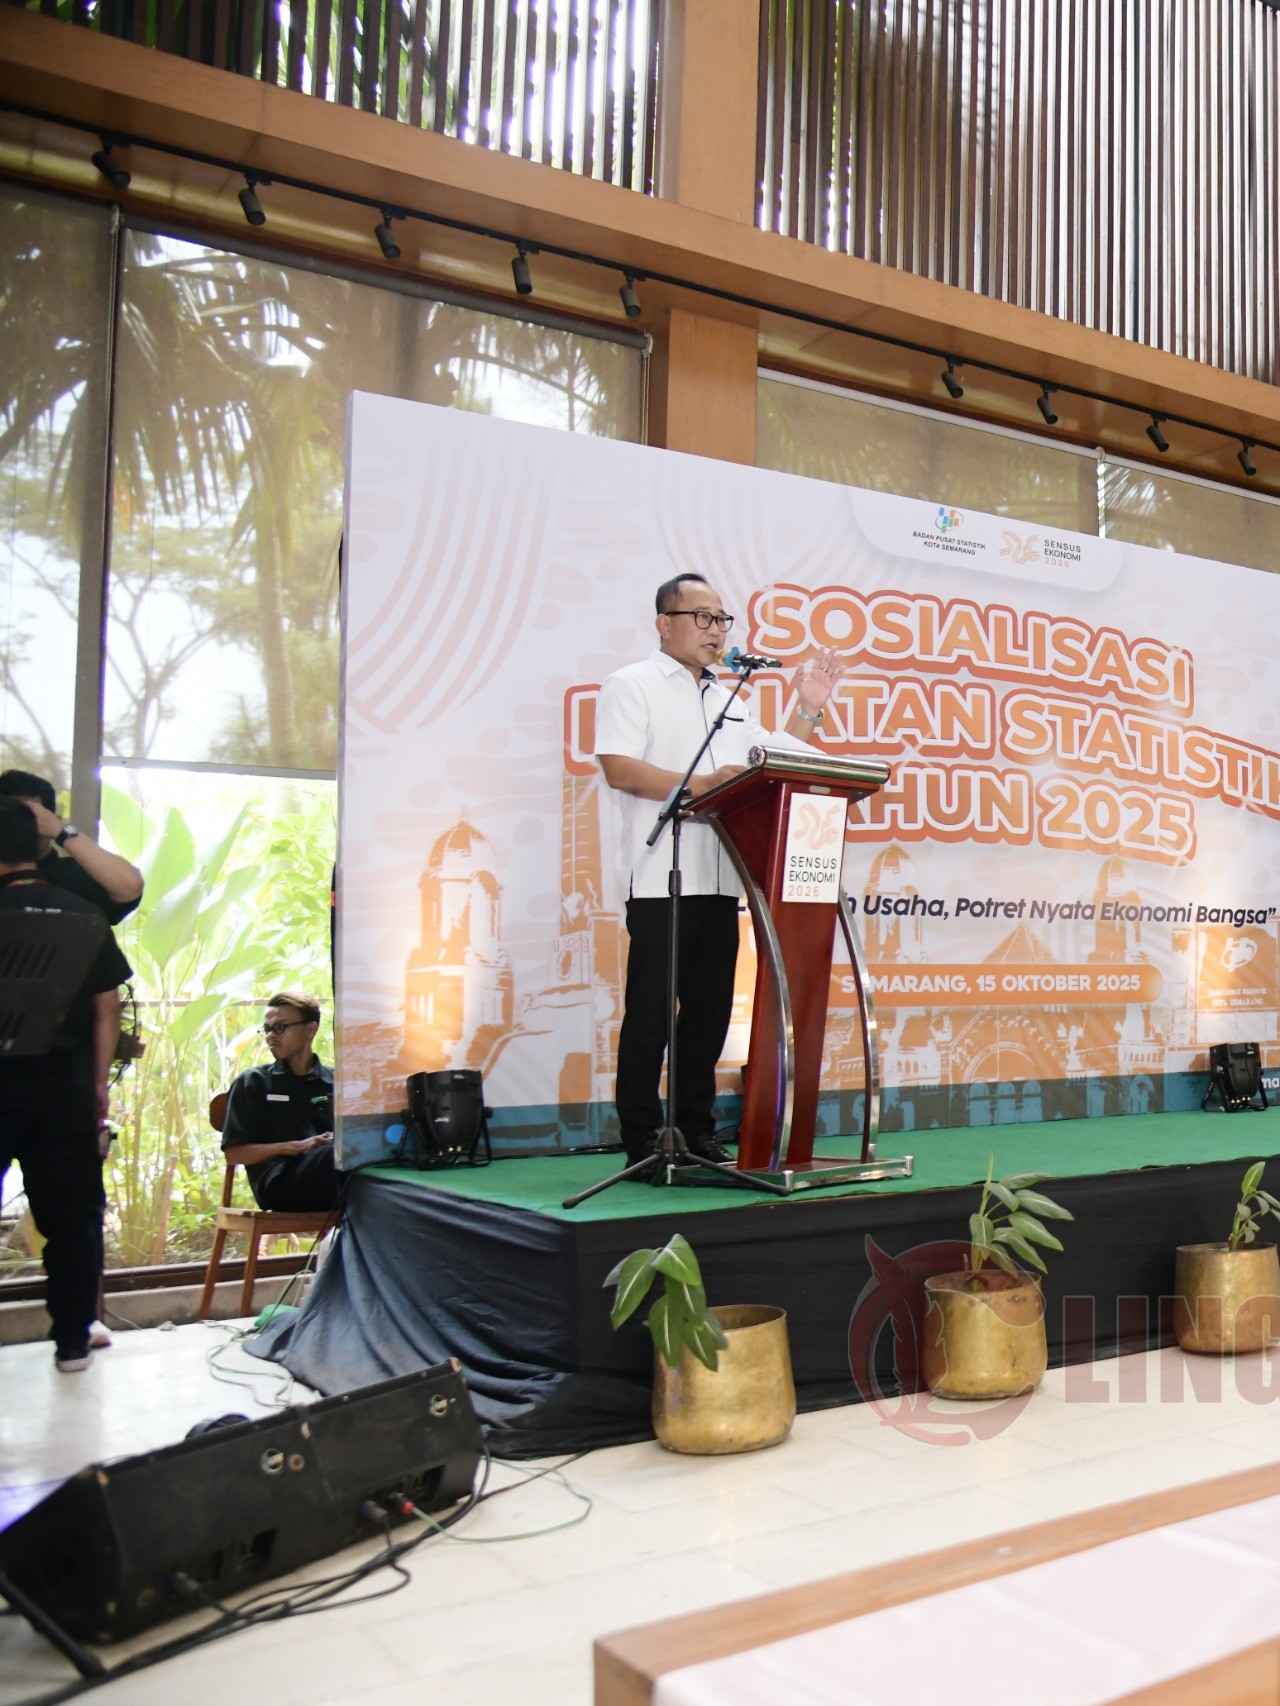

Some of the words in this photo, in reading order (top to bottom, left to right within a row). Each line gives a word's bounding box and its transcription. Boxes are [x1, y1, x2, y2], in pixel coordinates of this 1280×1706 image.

[912, 531, 934, 540] BADAN
[936, 535, 956, 544] PUSAT
[957, 539, 986, 550] STATISTIK
[1044, 539, 1081, 553] SENSUS
[923, 541, 941, 550] KOTA
[941, 544, 976, 556] SEMARANG
[1044, 548, 1081, 562] EKONOMI
[1044, 556, 1070, 568] 2026
[756, 592, 1187, 704] SOSIALISASI
[848, 767, 1029, 832] HUN
[1042, 777, 1190, 855] 2025
[790, 856, 837, 869] SENSUS
[789, 870, 836, 883] EKONOMI
[788, 885, 820, 897] 2026
[863, 894, 949, 920] Usaha,
[955, 897, 1026, 919] Potret
[1029, 900, 1096, 924] Nyata
[1100, 902, 1192, 923] Ekonomi
[841, 974, 972, 994] SMARANG,
[976, 974, 996, 991] 15
[1001, 975, 1092, 992] OKTOBER
[1096, 974, 1141, 992] 2025
